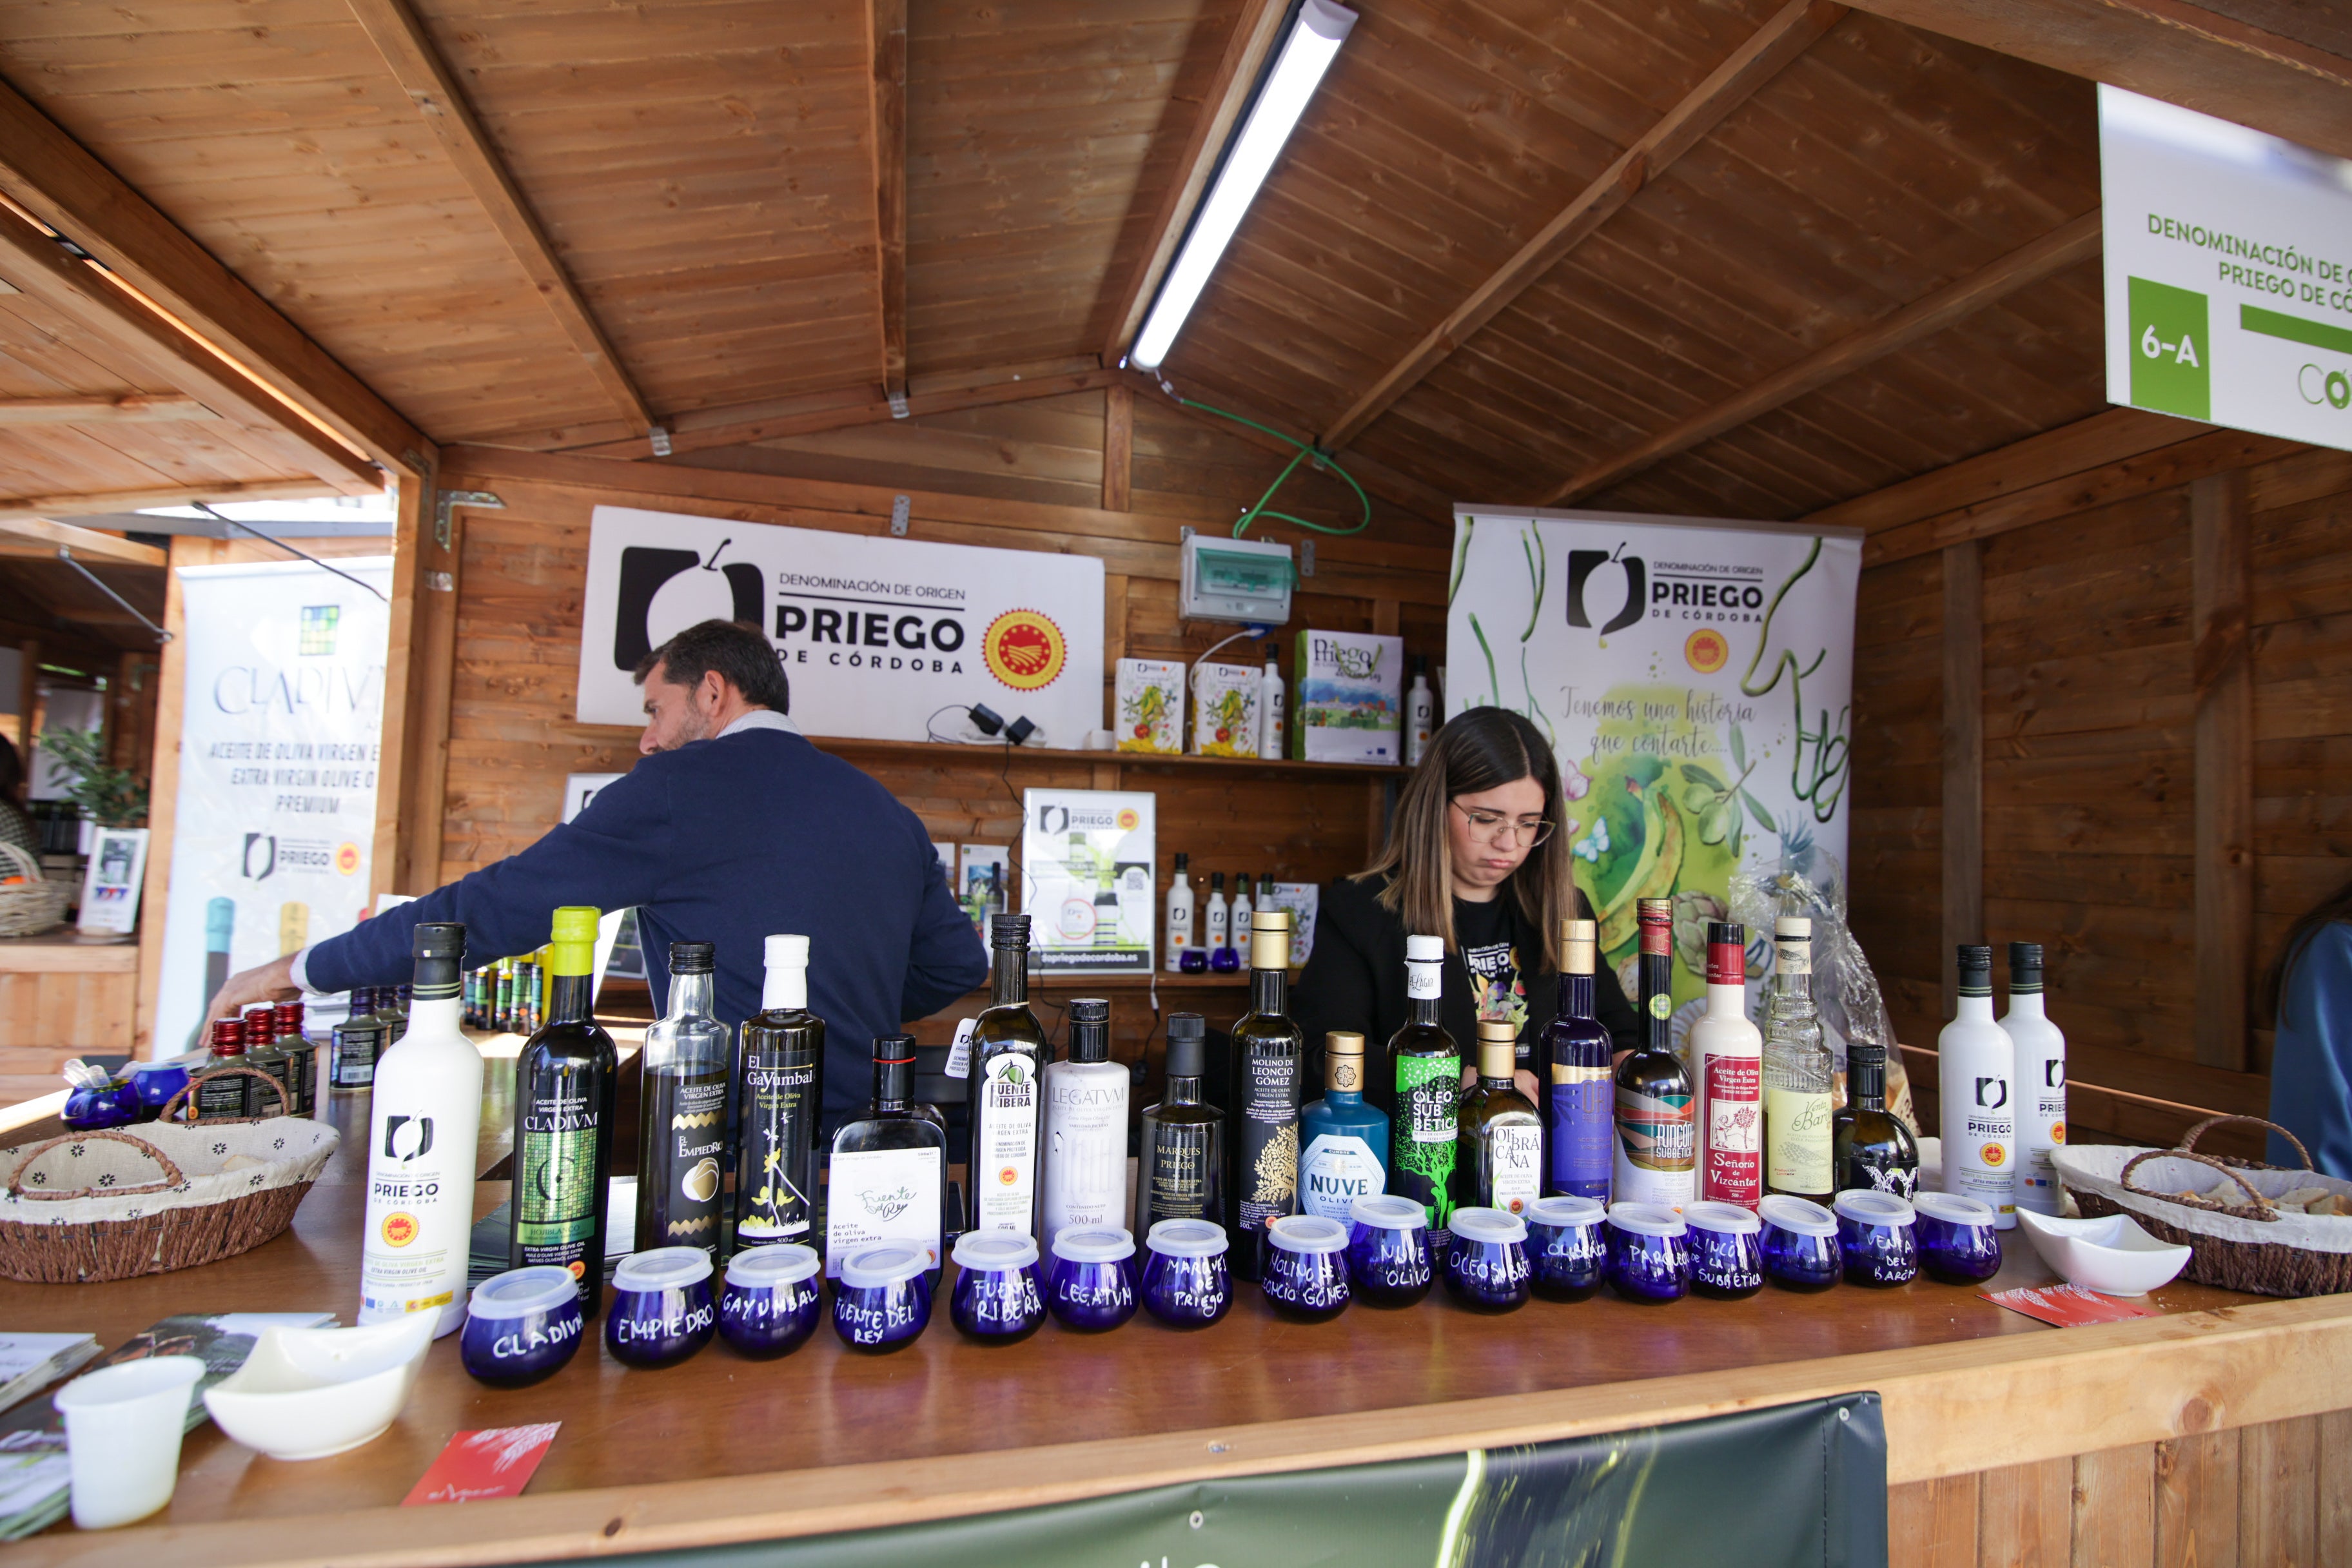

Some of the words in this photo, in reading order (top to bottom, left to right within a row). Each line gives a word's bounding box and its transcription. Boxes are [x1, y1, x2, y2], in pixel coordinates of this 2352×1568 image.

[2148, 213, 2313, 274] DENOMINACIÓN
[2319, 260, 2343, 283] DE
[2219, 261, 2295, 298] PRIEGO
[2301, 282, 2326, 306] DE
[2141, 324, 2200, 369] 6-A
[1653, 561, 1718, 574] DENOMINACIÓN
[1720, 565, 1730, 574] DE
[1731, 566, 1763, 575] ORIGEN
[779, 572, 892, 596] DENOMINACIÓN
[894, 581, 912, 597] DE
[915, 585, 965, 601] ORIGEN
[1652, 582, 1764, 609] PRIEGO
[1652, 609, 1671, 619] DE
[1683, 609, 1763, 623] CÓRDOBA
[776, 605, 965, 652] PRIEGO
[776, 650, 808, 664] DE
[829, 650, 963, 674] CÓRDOBA
[1560, 685, 1636, 723] Tenemos
[1643, 700, 1675, 722] una
[1685, 689, 1756, 723] historia
[1589, 732, 1625, 765] que
[1072, 816, 1113, 825] PRIEGO
[280, 850, 331, 866] PRIEGO
[748, 1055, 760, 1069] El
[1251, 1058, 1284, 1066] MOLINO
[1251, 1066, 1293, 1076] LEONCIO
[1713, 1067, 1736, 1076] Aceite
[1719, 1075, 1741, 1084] Virgen
[1255, 1075, 1290, 1086] GÓMEZ
[684, 1092, 709, 1100] VIRGEN
[990, 1083, 1030, 1096] FUENTE
[1052, 1086, 1124, 1105] LEGATVM
[1413, 1090, 1453, 1104] OLEO
[569, 1096, 588, 1104] OLIVA
[990, 1095, 1032, 1108] RIBERA
[1805, 1098, 1827, 1113] Venta
[538, 1105, 562, 1113] VIRGEN
[1413, 1103, 1442, 1117] SUB
[524, 1112, 598, 1131] CLADIVM
[1413, 1114, 1458, 1131] BÉTICA
[1791, 1110, 1832, 1132] Baró
[1968, 1122, 2012, 1133] PRIEGO
[1161, 1159, 1195, 1170] PRIEGO
[1509, 1154, 1530, 1168] NA
[1714, 1152, 1755, 1169] Señorío
[1309, 1173, 1368, 1196] NUVE
[1710, 1168, 1757, 1187] Vizcántar
[375, 1182, 438, 1197] PRIEGO
[855, 1186, 917, 1210] Fuente
[1068, 1214, 1088, 1225] 500
[1091, 1214, 1102, 1224] ml
[1692, 1234, 1744, 1257] RINCÓ
[1867, 1234, 1914, 1254] VENTA
[1380, 1244, 1426, 1266] NUVE
[1885, 1255, 1907, 1268] DEL
[1269, 1252, 1315, 1282] MOLINO
[1195, 1279, 1214, 1291] DE
[1386, 1266, 1431, 1288] OLIVO
[972, 1277, 1035, 1300] FUENTE
[1262, 1277, 1296, 1301] EONCIO
[723, 1288, 819, 1321] GAYUMBAL
[836, 1296, 884, 1329] FUENTE
[886, 1304, 915, 1328] DEL
[977, 1295, 1043, 1323] RIBERA
[618, 1304, 714, 1344] EMPIEDRO
